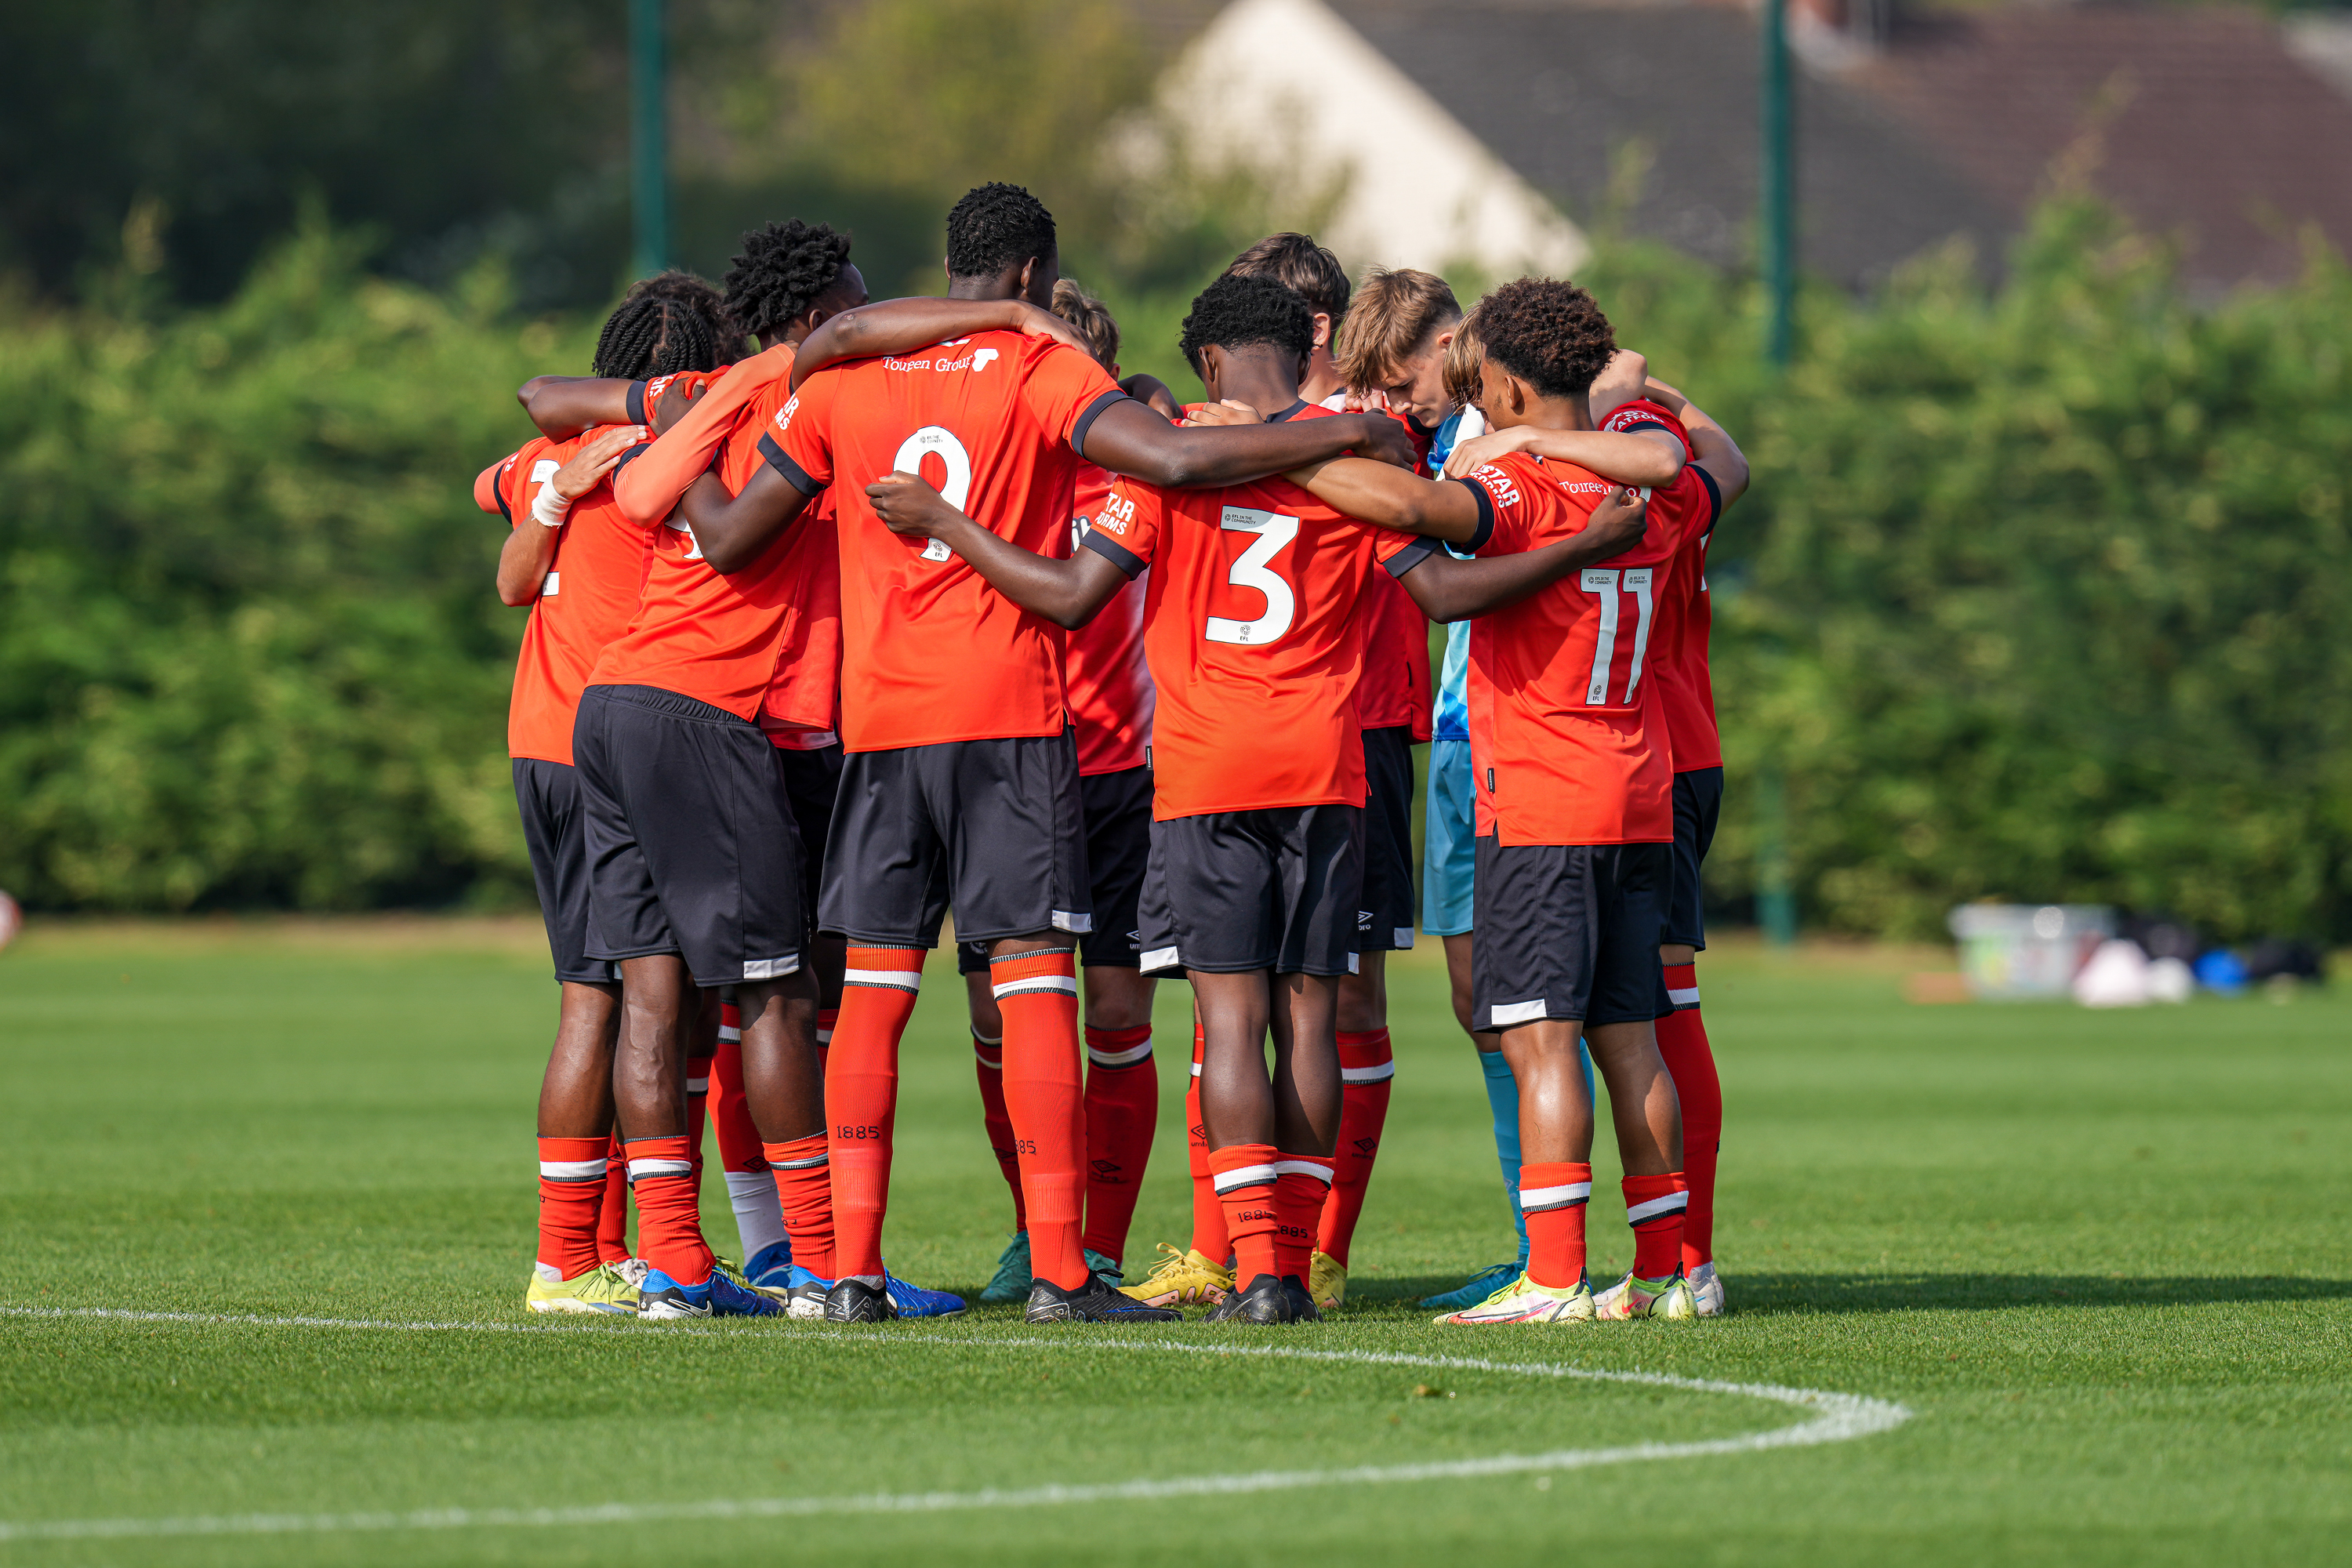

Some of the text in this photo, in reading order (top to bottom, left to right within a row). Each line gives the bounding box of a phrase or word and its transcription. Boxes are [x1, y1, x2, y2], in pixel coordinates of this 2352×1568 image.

[893, 425, 971, 562] 9
[1477, 464, 1520, 507] STAR
[1105, 492, 1135, 523] TAR
[1205, 505, 1300, 645] 3
[837, 1125, 880, 1140] 1885
[1237, 1209, 1273, 1223] 1885
